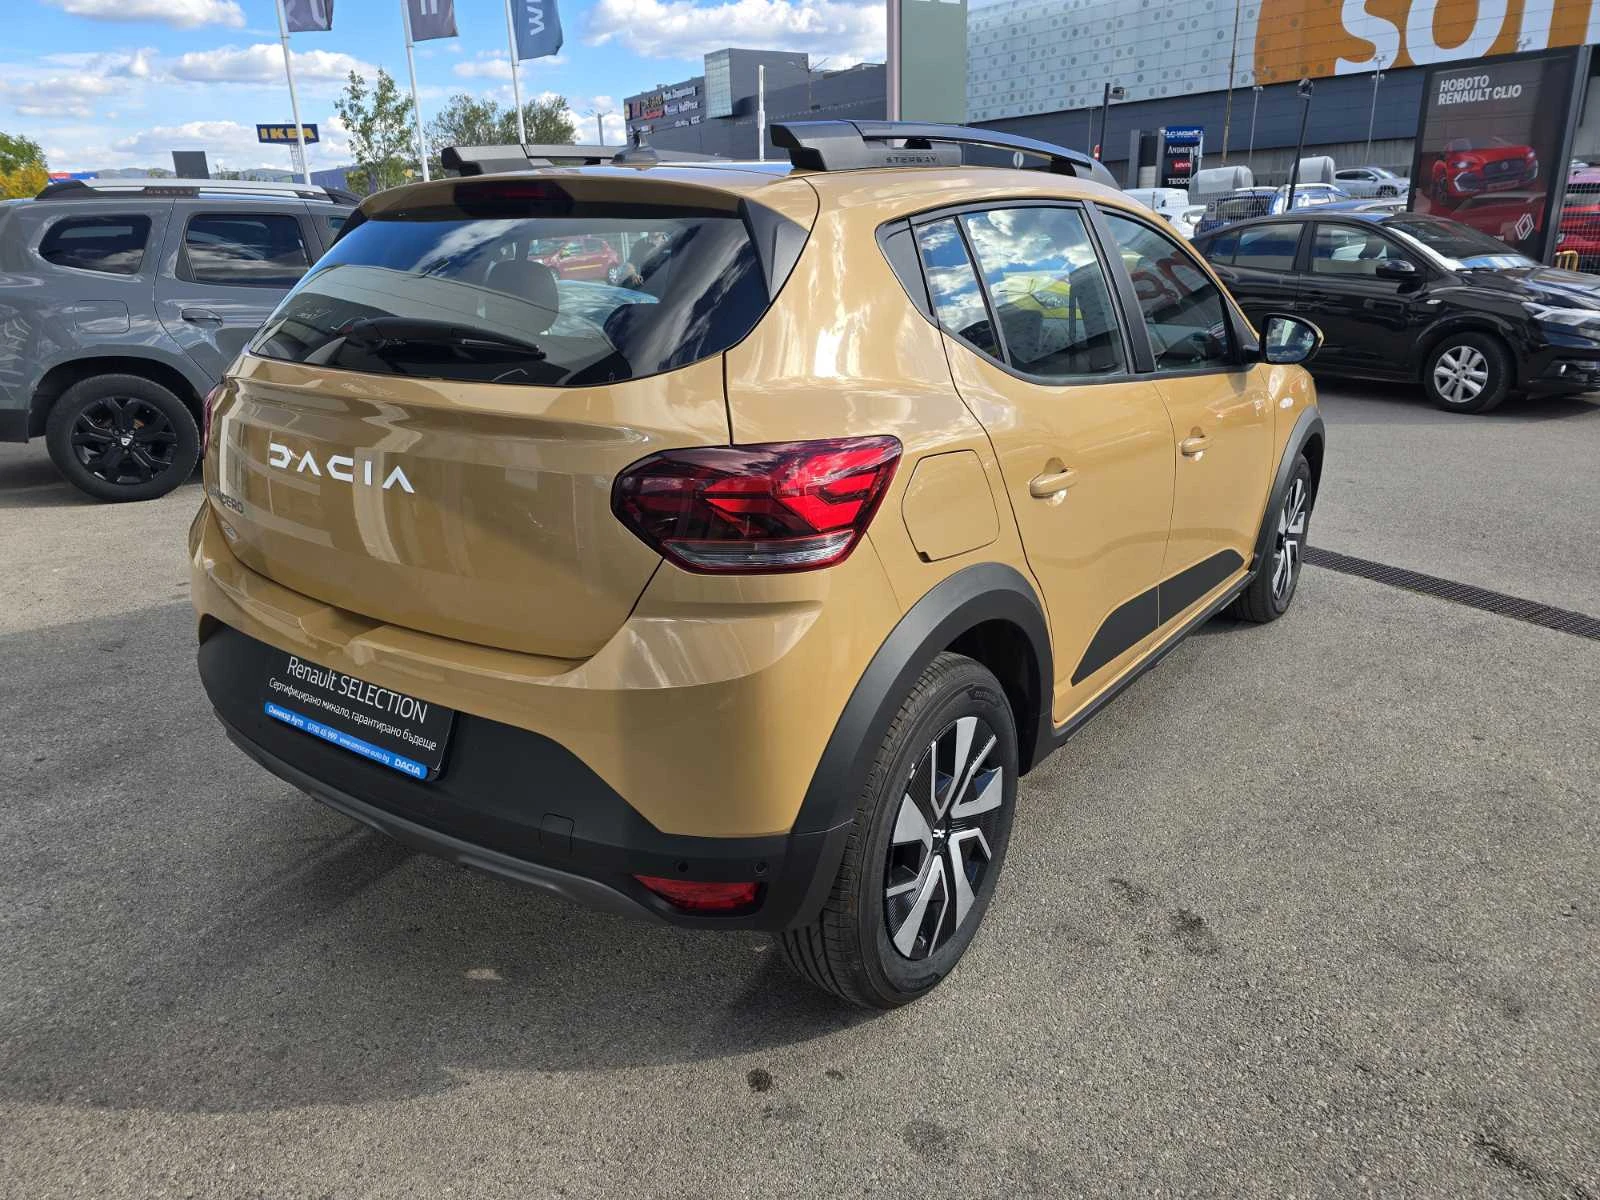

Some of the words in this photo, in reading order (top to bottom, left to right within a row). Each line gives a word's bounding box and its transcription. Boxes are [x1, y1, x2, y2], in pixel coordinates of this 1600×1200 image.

[1440, 75, 1489, 92] НОВОТО
[1438, 88, 1492, 105] RENAULT
[1493, 85, 1522, 99] CLIO
[260, 127, 316, 139] IKEA
[269, 442, 416, 493] DACIA
[287, 656, 337, 691] Renault
[338, 675, 429, 724] SELECTION
[269, 677, 321, 707] Сертифицирано
[322, 700, 350, 719] минало,
[351, 712, 401, 737] гарантирано
[402, 728, 437, 751] бъдеще
[394, 758, 421, 776] DACIA
